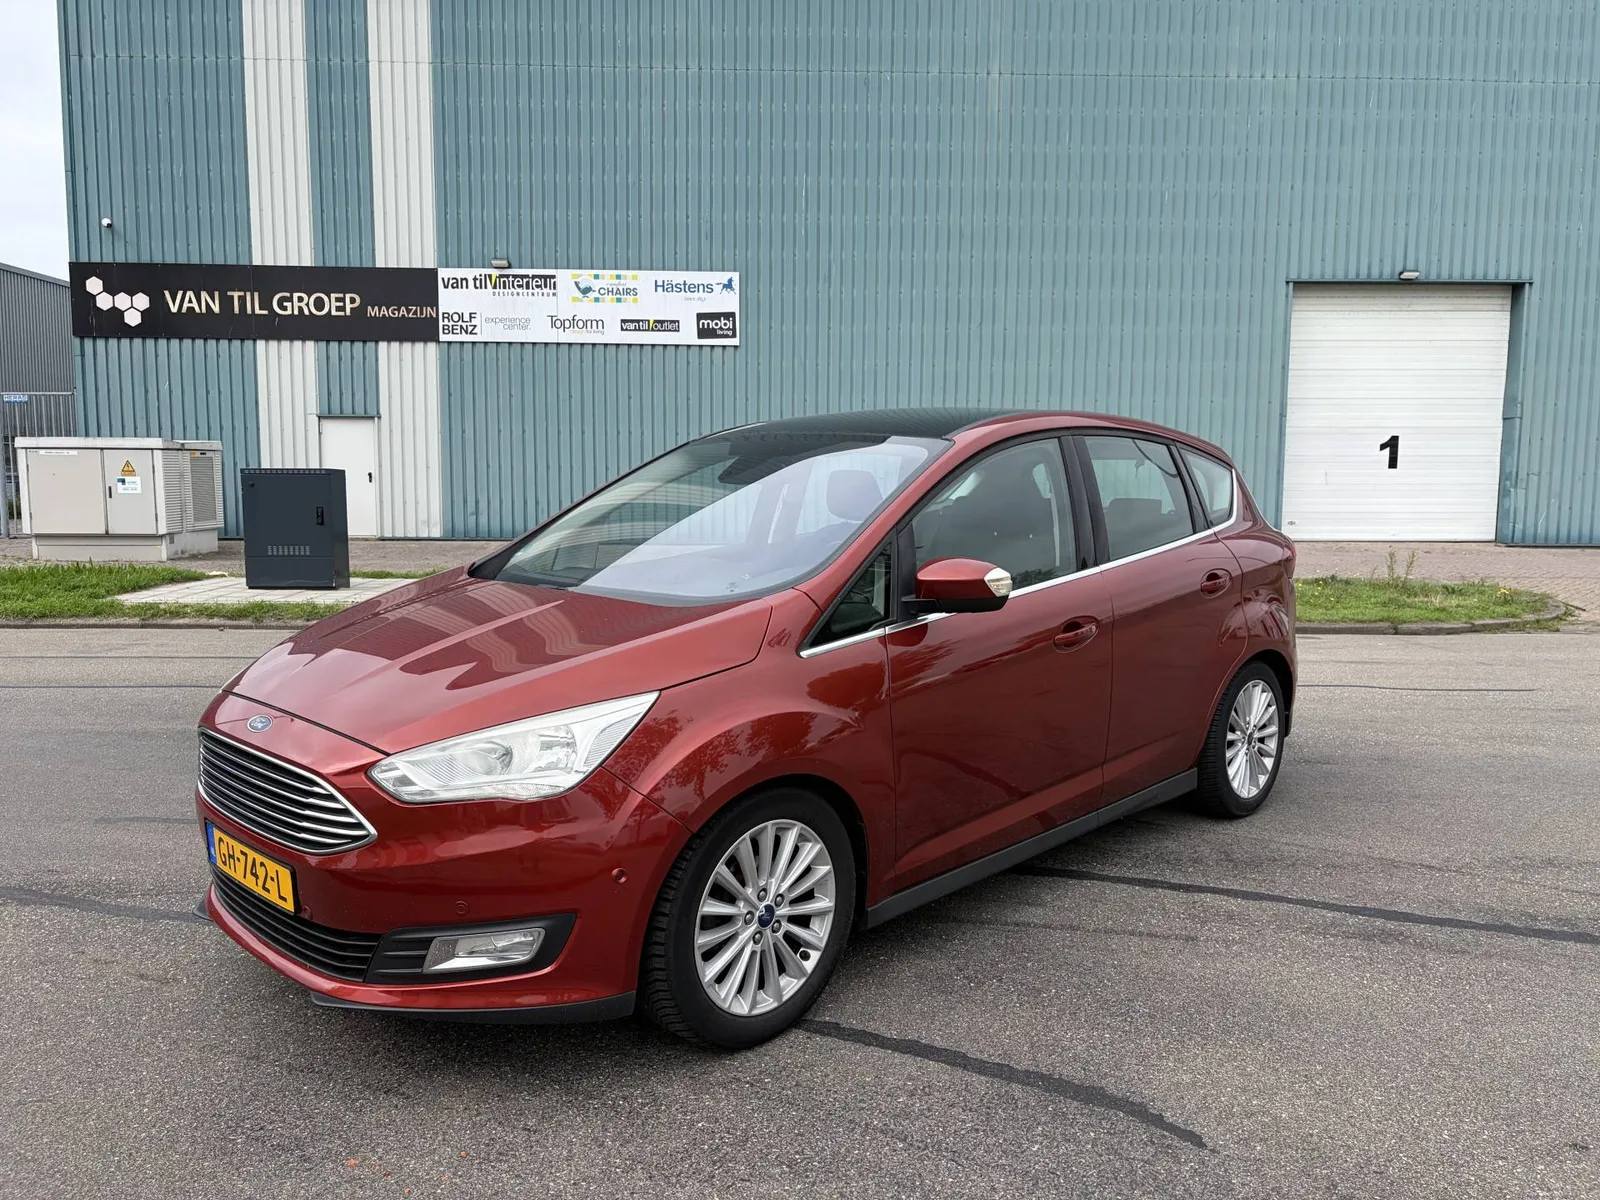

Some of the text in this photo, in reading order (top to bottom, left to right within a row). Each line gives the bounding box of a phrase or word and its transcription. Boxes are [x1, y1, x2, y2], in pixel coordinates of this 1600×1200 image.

[441, 273, 557, 291] van til interieur
[654, 279, 714, 294] Hästens
[597, 286, 638, 297] CHAIRS
[163, 290, 437, 318] VAN TIL GROEP MAGAZIJN
[441, 312, 477, 323] ROLF
[484, 316, 531, 326] experience
[546, 314, 605, 333] Topform
[699, 316, 733, 329] mobi
[441, 324, 478, 335] BENZ
[621, 320, 680, 331] van til outlet
[1379, 435, 1400, 469] 1
[217, 836, 288, 903] GH-742-L
